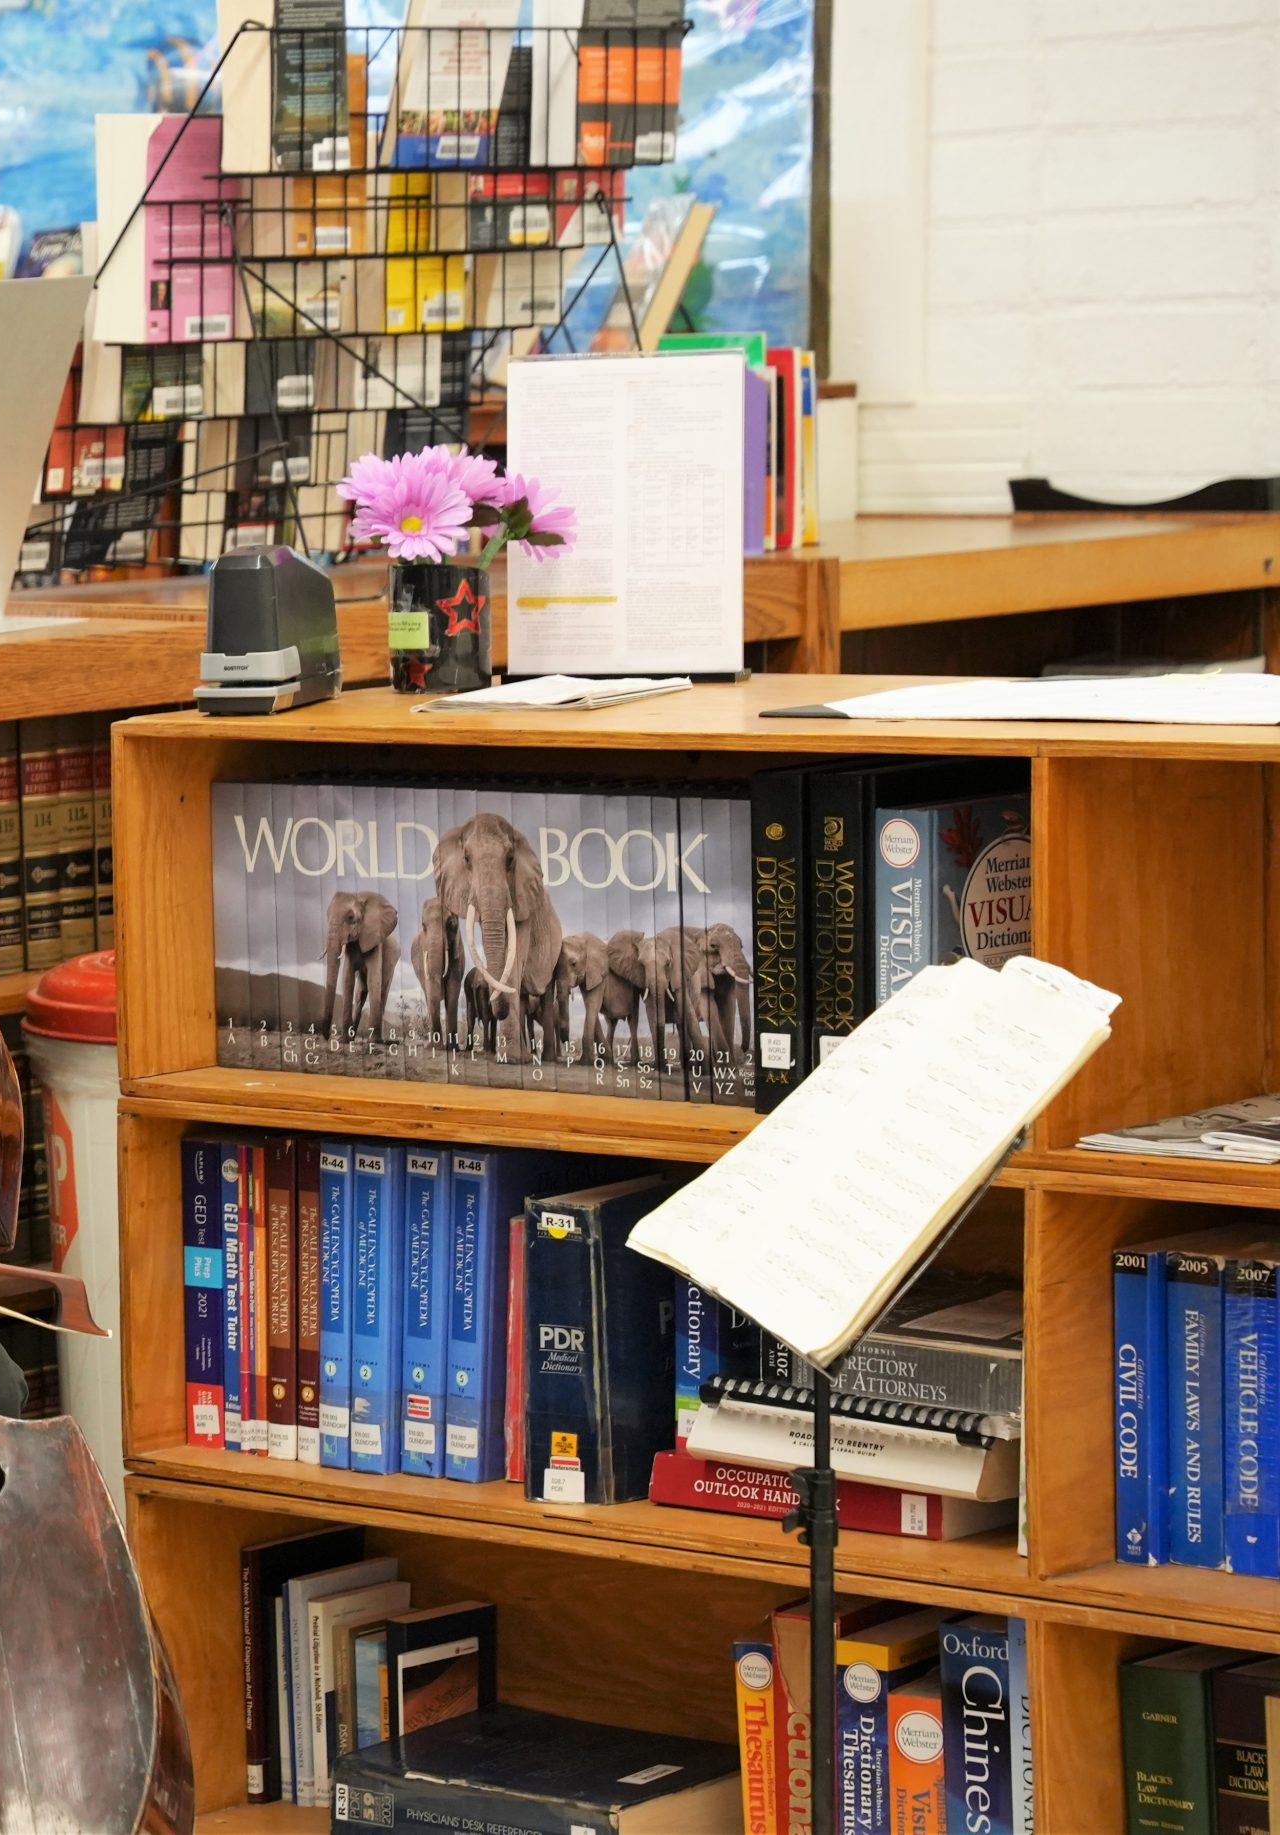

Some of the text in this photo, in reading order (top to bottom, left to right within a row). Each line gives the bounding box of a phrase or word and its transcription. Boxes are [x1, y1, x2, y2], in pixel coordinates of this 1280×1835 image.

[234, 815, 712, 894] WORLD BOOK
[756, 856, 779, 1027] DICTIONARY
[777, 857, 798, 1026] WORLD BOOK
[815, 859, 835, 1031] DICTIONARY
[835, 860, 855, 1031] WORLD BOOK
[228, 1017, 233, 1029] 1
[260, 1020, 267, 1032] 2
[286, 1021, 293, 1033] 3
[308, 1023, 315, 1034] 4
[330, 1025, 337, 1036] 5
[348, 1026, 355, 1038] 6
[368, 1027, 375, 1039] 7
[390, 1028, 396, 1040] 8
[227, 1033, 236, 1045] A
[261, 1035, 268, 1047] B
[427, 1032, 441, 1044] 10
[447, 1032, 460, 1045] 11
[467, 1034, 480, 1046] 12
[496, 1035, 507, 1049] 13
[531, 1038, 543, 1051] 14
[330, 1040, 340, 1051] D
[349, 1041, 355, 1053] E
[389, 1044, 398, 1056] G
[564, 1040, 576, 1053] 15
[593, 1042, 606, 1055] 16
[616, 1044, 630, 1057] 17
[639, 1045, 653, 1058] 18
[283, 1051, 298, 1063] Ch
[305, 1053, 320, 1065] Cz
[496, 1051, 508, 1064] M
[532, 1053, 542, 1066] N
[663, 1047, 677, 1060] 19
[689, 1049, 705, 1062] 20
[716, 1051, 730, 1064] 21
[451, 1064, 460, 1076] K
[593, 1057, 605, 1072] Q
[532, 1067, 543, 1081] O
[596, 1072, 604, 1085] R
[713, 1068, 736, 1080] WX
[616, 1075, 630, 1088] Sn
[640, 1076, 653, 1089] Sz
[716, 1082, 734, 1096] YZ
[322, 1157, 344, 1169] R-44
[359, 1158, 381, 1170] R-45
[411, 1159, 434, 1171] R-47
[458, 1160, 481, 1171] R-48
[195, 1195, 207, 1245] GED Test
[224, 1203, 238, 1233] GED
[546, 1217, 571, 1229] R-31
[226, 1238, 238, 1279] Math
[322, 1230, 330, 1285] MEDICINE
[330, 1186, 340, 1321] The GALE ENCYCLOPEDIA
[194, 1257, 202, 1277] Plus
[204, 1256, 212, 1279] Prep
[455, 1238, 464, 1294] MEDICINE
[463, 1193, 475, 1330] The GALE ENCYCLOPEDIA
[1116, 1254, 1146, 1269] 2001
[1177, 1259, 1208, 1274] 2005
[1237, 1268, 1271, 1283] 2007
[227, 1282, 238, 1312] Test
[198, 1292, 207, 1318] 2021
[228, 1316, 238, 1351] Tutor
[539, 1327, 585, 1351] PDR
[547, 1352, 578, 1363] Medical
[541, 1361, 583, 1374] Dictionary
[852, 1372, 947, 1402] ATTORNEYS
[1118, 1343, 1138, 1479] CIVIL CODE
[1184, 1309, 1201, 1544] FAMILY LAWS AND RULES
[1238, 1333, 1259, 1507] VEHICLE CODE
[846, 1439, 885, 1452] REENTRY
[694, 1480, 759, 1500] OUTLOOK
[943, 1633, 1009, 1661] Oxford
[1142, 1712, 1178, 1725] GARNER
[900, 1725, 941, 1739] Merriam-
[901, 1737, 938, 1750] Webster
[962, 1666, 1005, 1835] Chines
[744, 1697, 769, 1835] Thesaurus
[857, 1714, 875, 1831] Dictionary
[1244, 1765, 1264, 1779] LAW
[843, 1729, 861, 1835] Thesaurus
[1137, 1783, 1158, 1794] LAW
[338, 1786, 346, 1816] R-30
[1138, 1793, 1195, 1811] DICTIONARY
